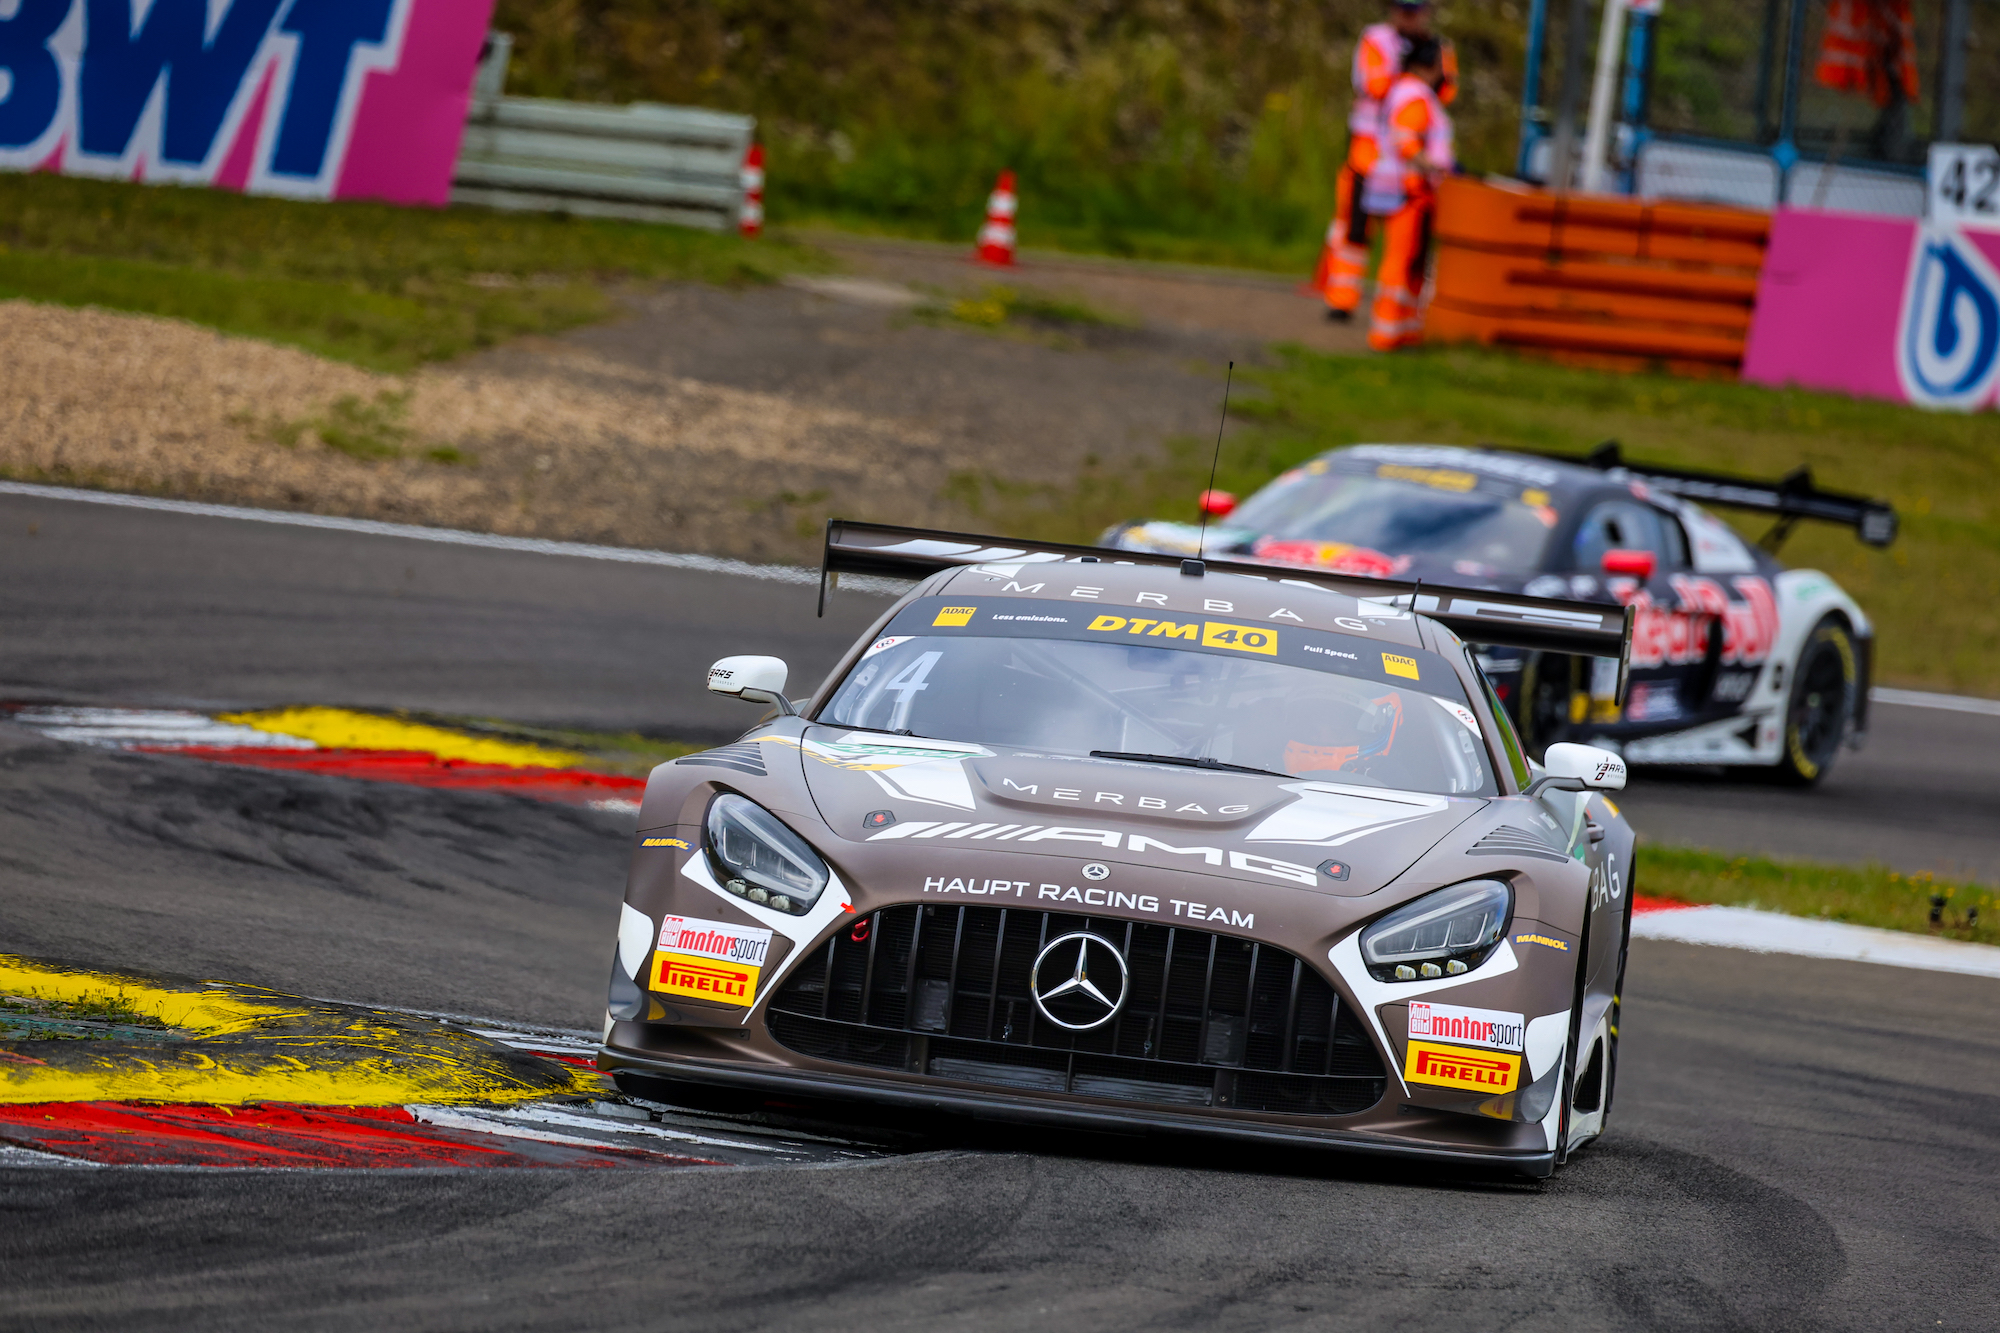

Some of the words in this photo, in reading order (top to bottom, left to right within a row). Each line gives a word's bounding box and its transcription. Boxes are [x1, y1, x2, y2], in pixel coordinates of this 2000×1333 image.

[1939, 158, 2000, 213] 42
[941, 607, 975, 616] ADAC
[992, 613, 1014, 621] Less
[1015, 614, 1068, 623] emissions.
[1001, 581, 1368, 631] MERBAG
[1087, 615, 1199, 640] DTM
[1212, 629, 1268, 648] 40
[1303, 645, 1323, 655] Full
[1324, 648, 1358, 661] Speed.
[1384, 654, 1415, 667] ADAC
[885, 651, 944, 703] 4
[1003, 777, 1249, 815] MERBAG
[641, 838, 689, 850] MANNOL
[1017, 825, 1318, 887] AMG
[923, 876, 1030, 898] HAUPT
[1037, 883, 1159, 913] RACING
[1169, 898, 1255, 929] TEAM
[677, 930, 767, 961] motorsport
[1516, 934, 1568, 951] MANNOL
[659, 960, 748, 997] PIRELLI
[1410, 1004, 1430, 1019] Auto
[1411, 1018, 1430, 1034] Bild
[1432, 1016, 1522, 1047] motorsport
[1416, 1050, 1511, 1086] PIRELLI
